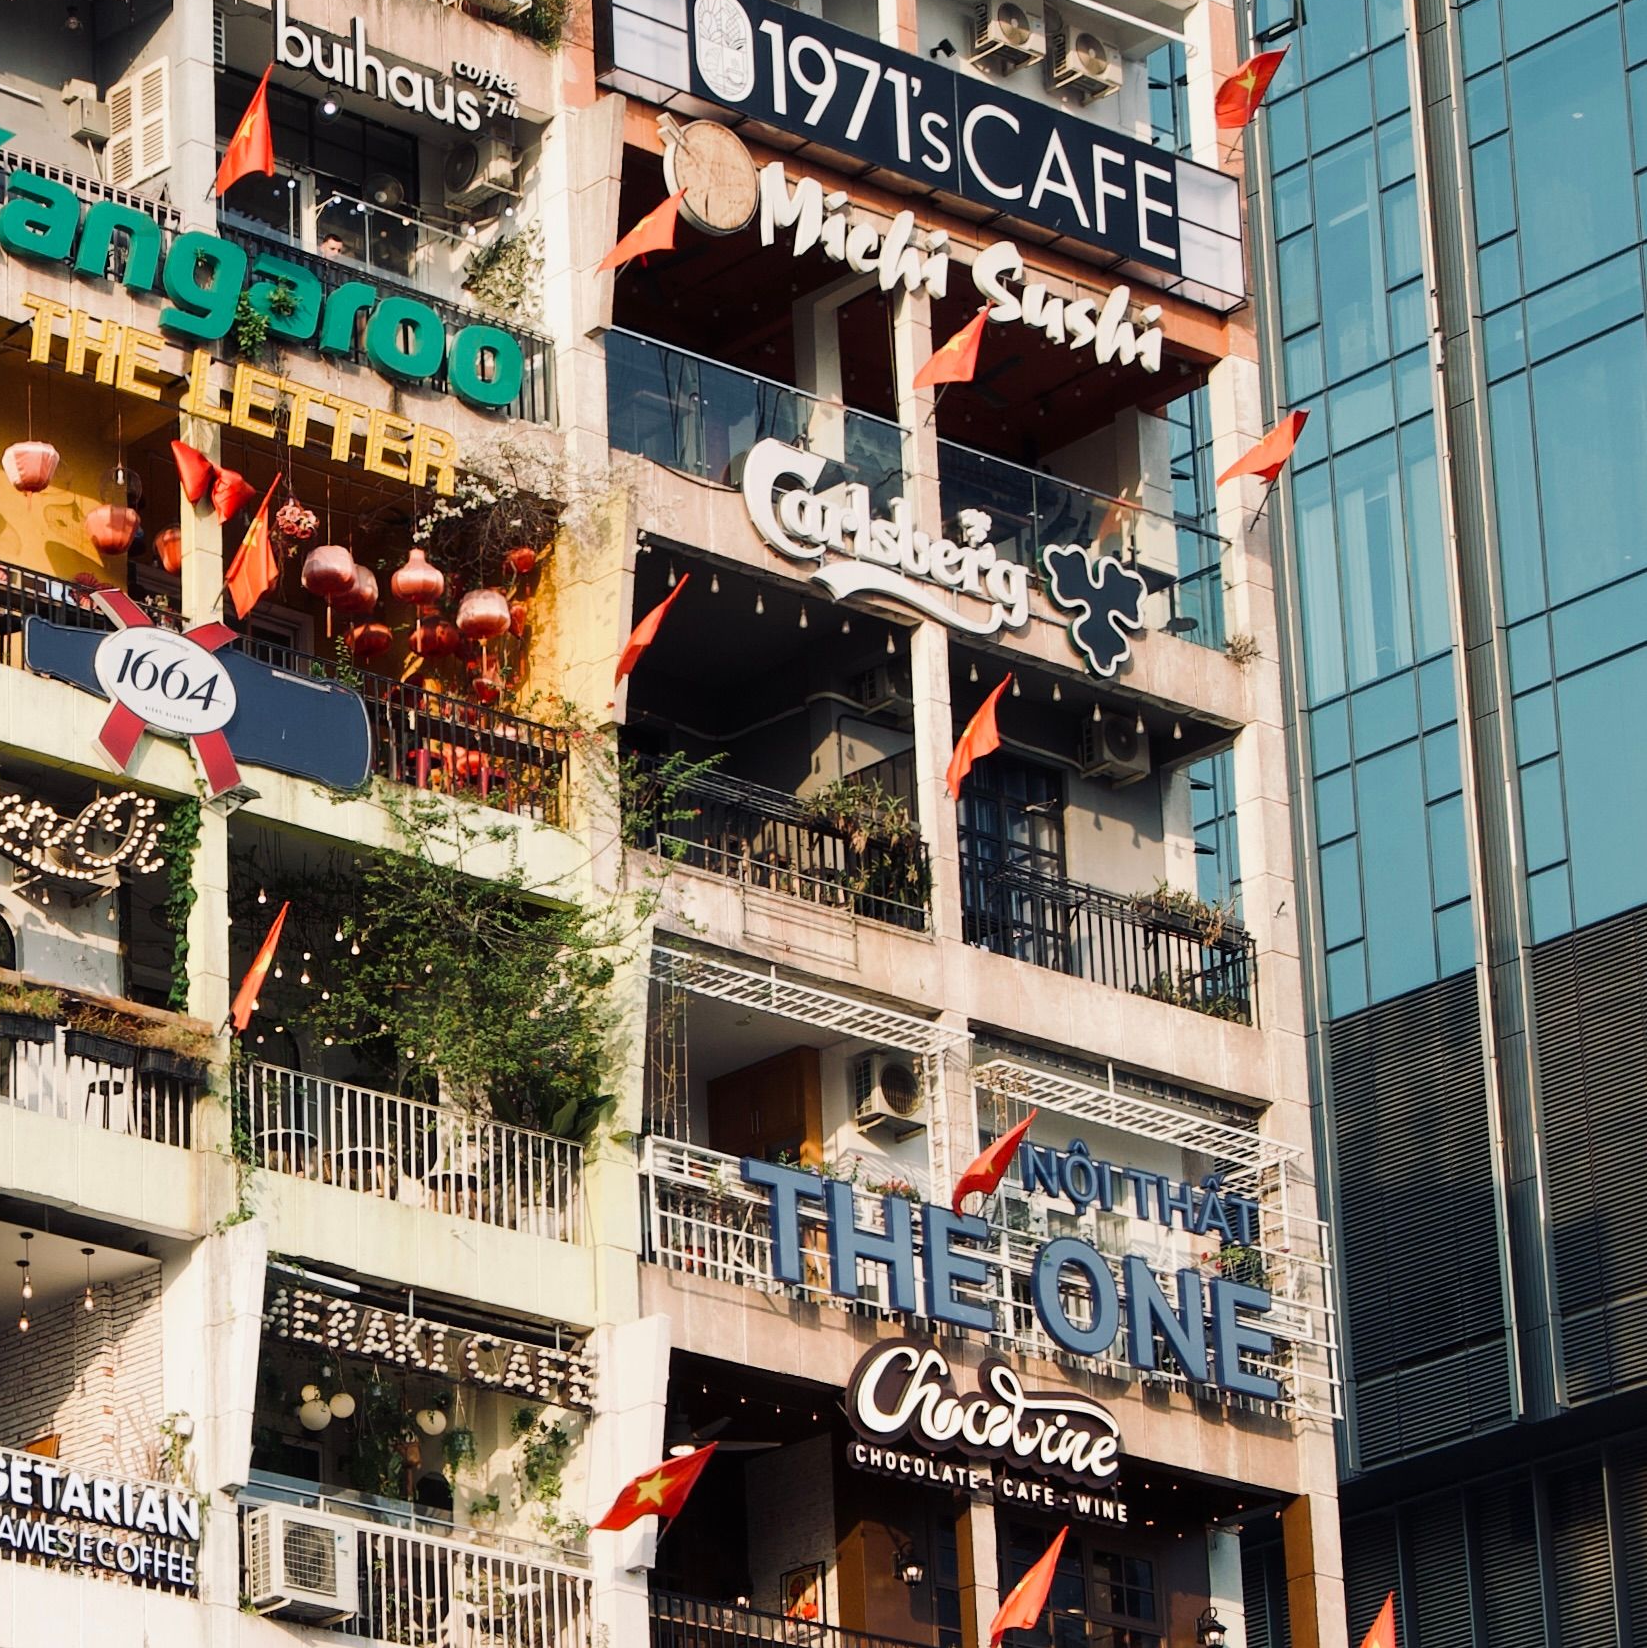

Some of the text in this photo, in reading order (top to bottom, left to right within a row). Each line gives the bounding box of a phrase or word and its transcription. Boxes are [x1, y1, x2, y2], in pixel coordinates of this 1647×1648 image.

[455, 60, 519, 97] coffee
[484, 91, 520, 120] 7th
[758, 19, 1176, 260] 1971's CAFE
[760, 161, 1163, 372] Machi Sushi
[21, 292, 456, 495] THE LETTER
[743, 438, 1029, 634] Carlsberg
[117, 648, 227, 711] 1664
[1019, 1137, 1260, 1246] NỘI THẤT
[741, 1157, 1280, 1401] THE ONE
[855, 1444, 1129, 1523] CHOCOLATE CAFE WINE
[96, 1537, 196, 1587] COFFEE
